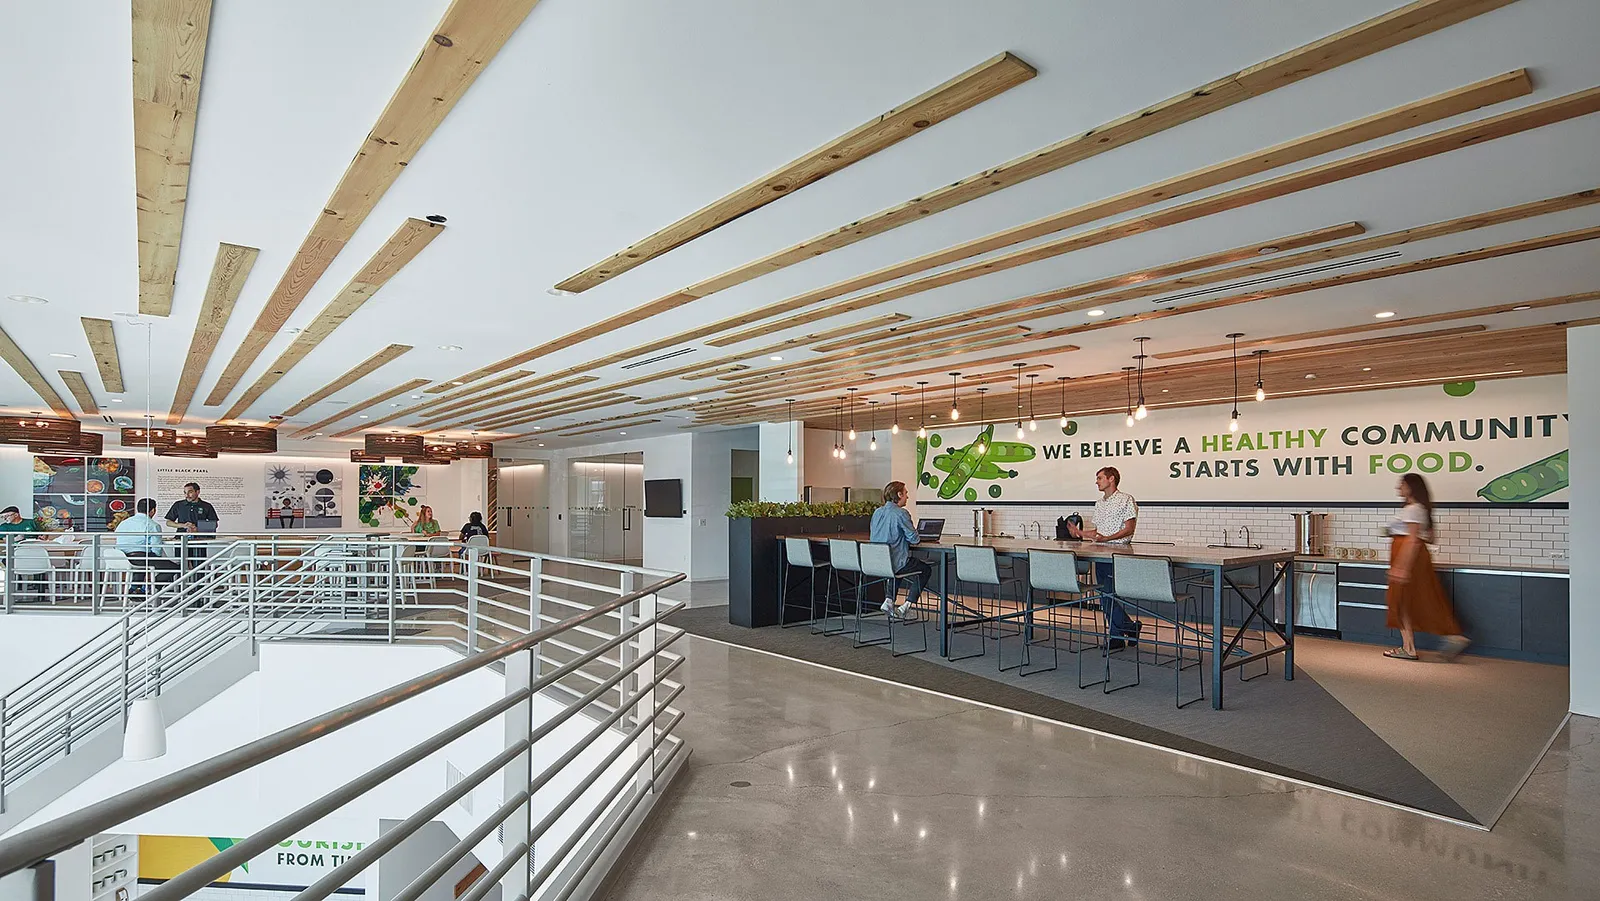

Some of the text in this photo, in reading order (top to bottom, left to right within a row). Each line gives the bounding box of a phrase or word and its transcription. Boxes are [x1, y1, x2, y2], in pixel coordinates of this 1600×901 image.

[1043, 414, 1569, 460] WE BELIEVE A HEALTHY COMMUNIT
[1169, 451, 1485, 478] STARTS WITH FOOD.
[278, 852, 324, 867] FROM
